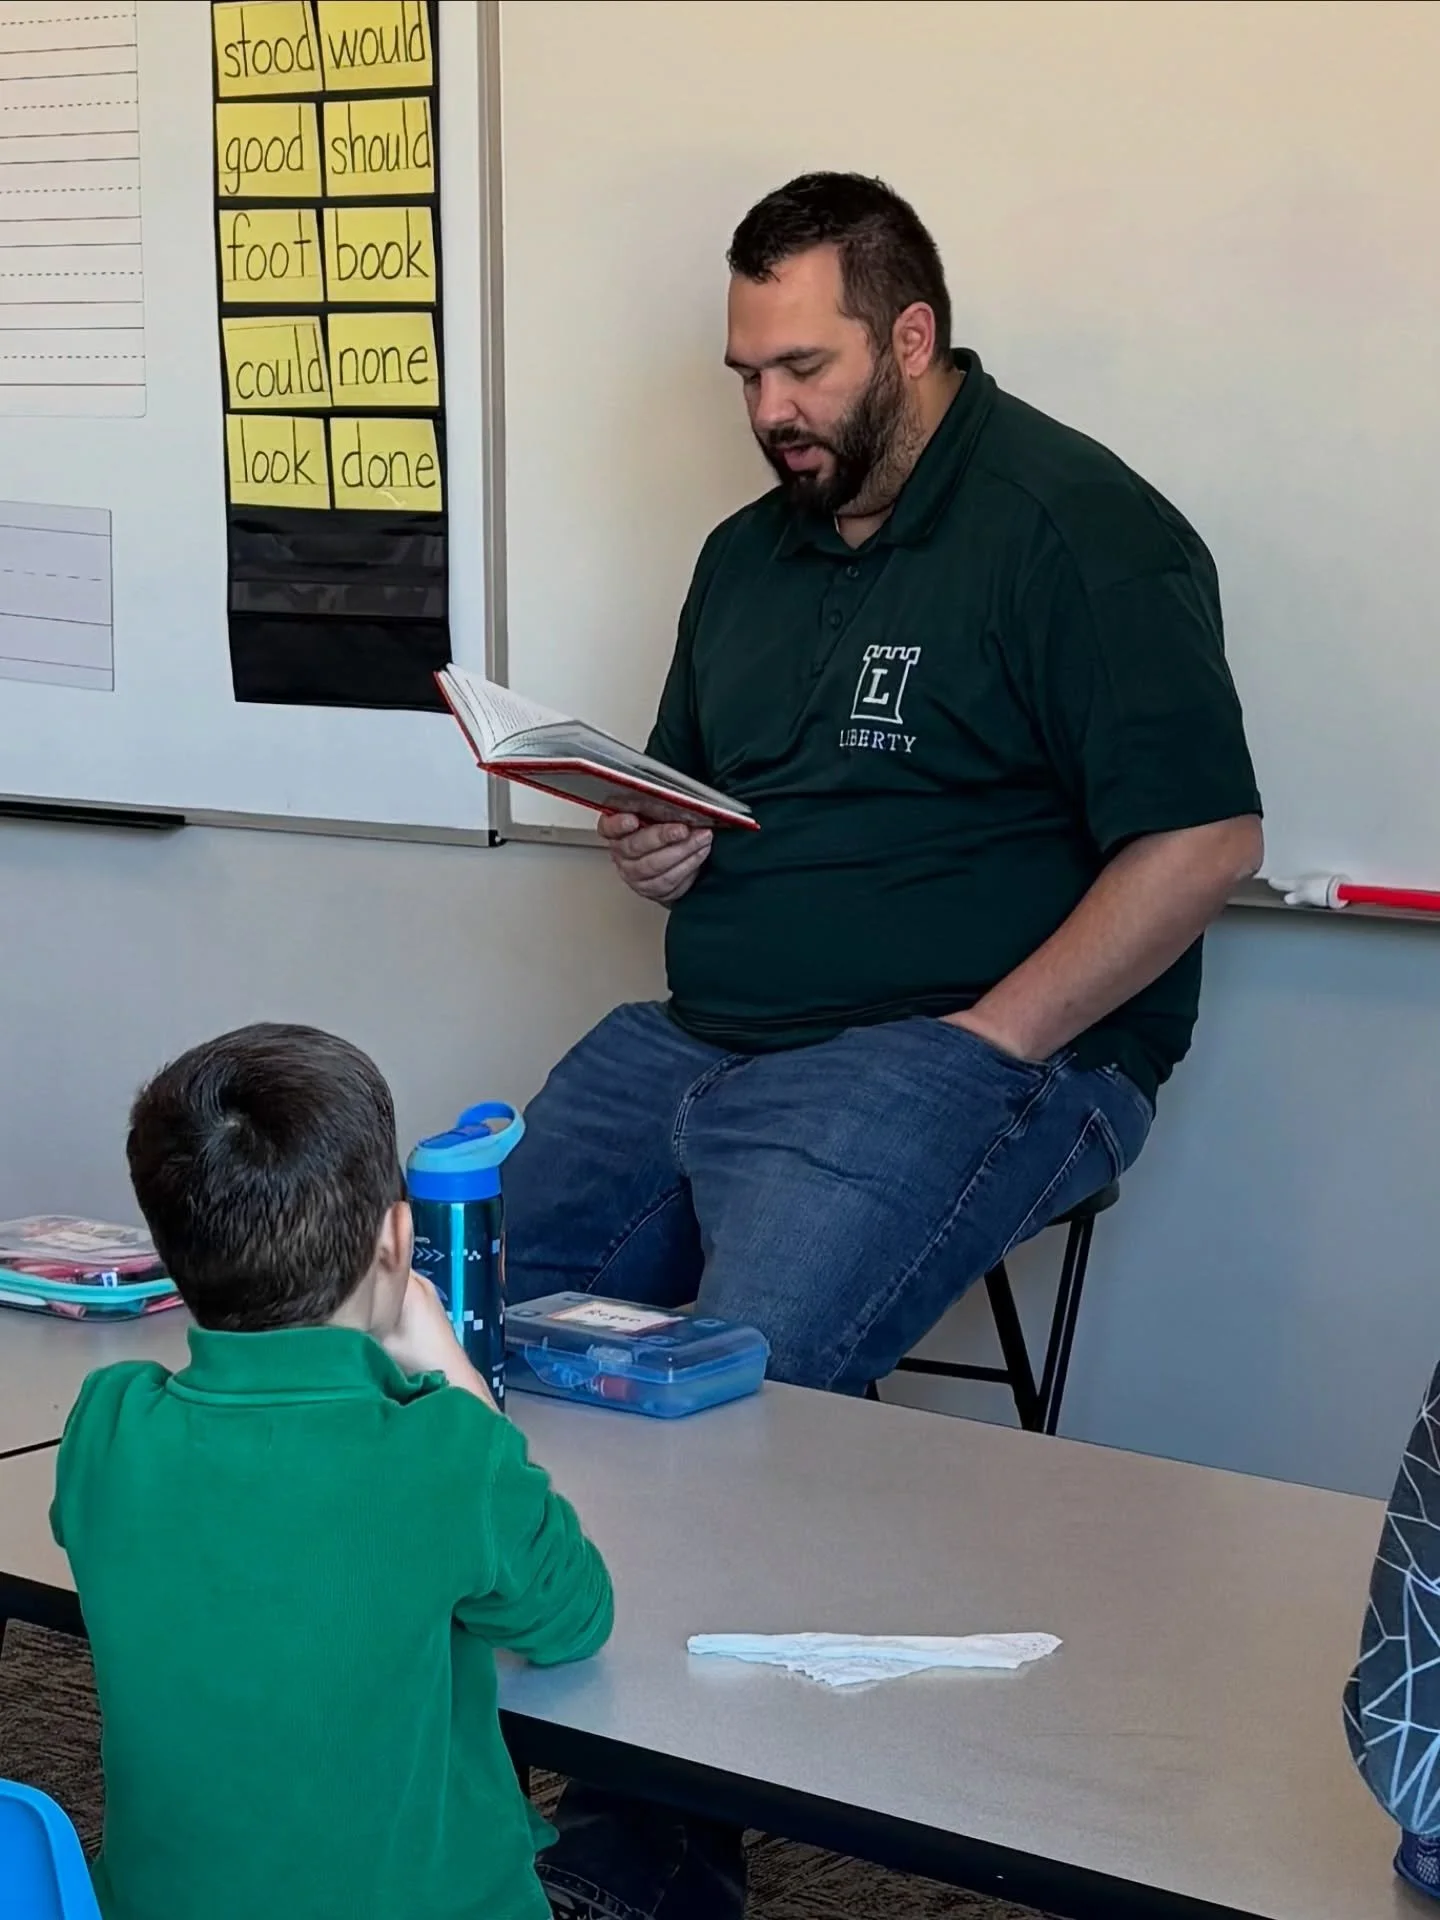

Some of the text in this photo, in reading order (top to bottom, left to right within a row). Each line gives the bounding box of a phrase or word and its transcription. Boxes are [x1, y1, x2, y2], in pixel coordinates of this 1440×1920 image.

[224, 2, 315, 78] stood
[328, 0, 426, 70] would
[225, 104, 304, 195] good
[331, 100, 431, 175] should
[227, 210, 312, 280] foot
[335, 208, 429, 281] book
[236, 323, 325, 399] could
[339, 345, 428, 386] none
[240, 417, 316, 485] look
[341, 421, 436, 488] done
[863, 668, 889, 705] L
[839, 729, 916, 753] LIBERTY
